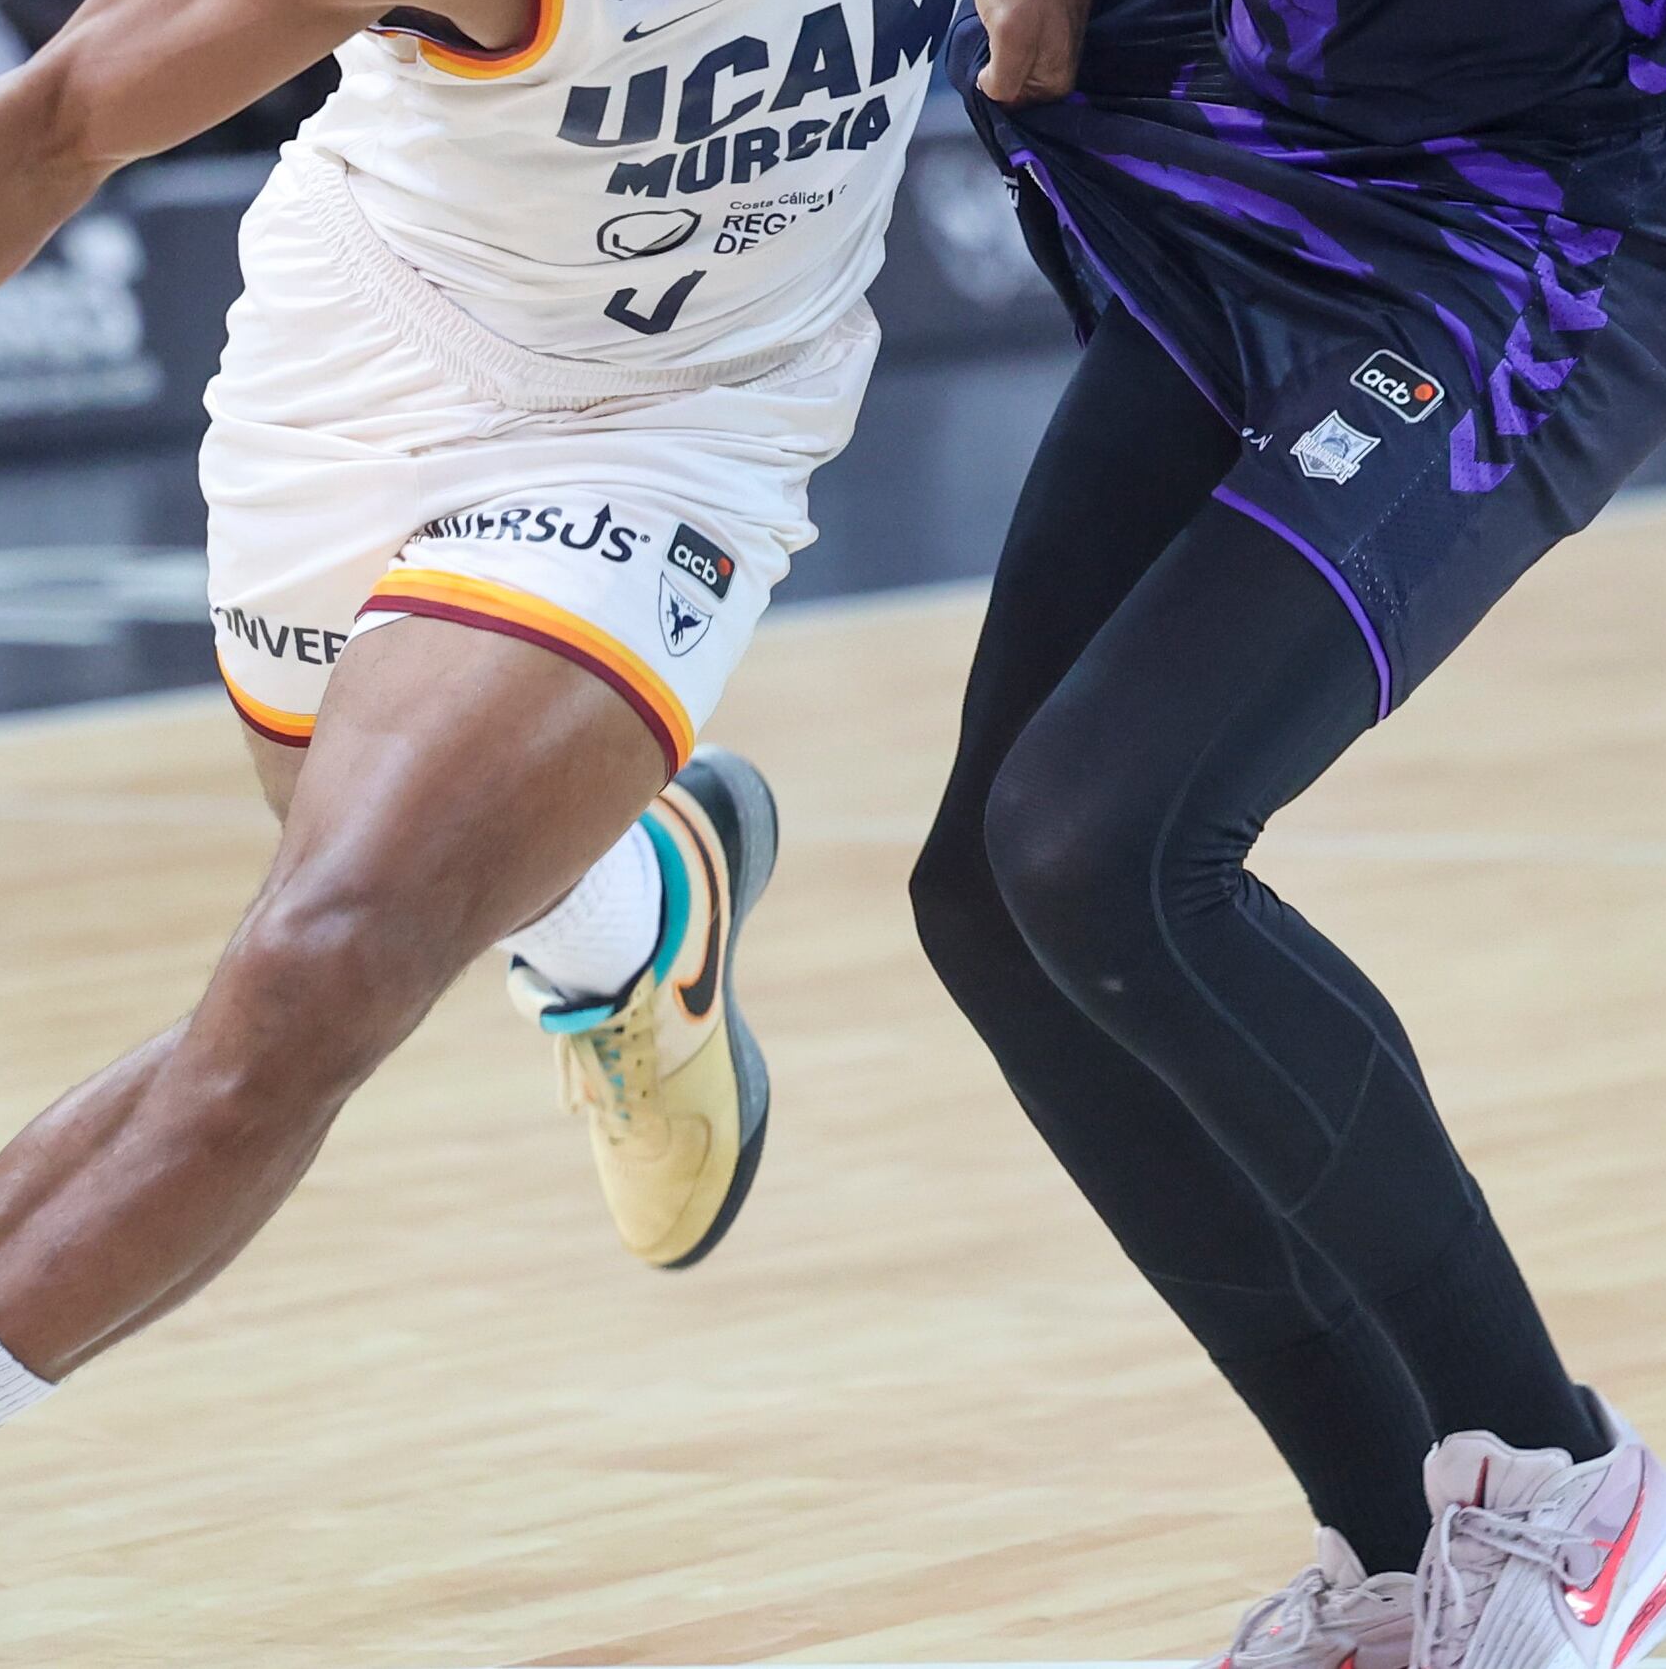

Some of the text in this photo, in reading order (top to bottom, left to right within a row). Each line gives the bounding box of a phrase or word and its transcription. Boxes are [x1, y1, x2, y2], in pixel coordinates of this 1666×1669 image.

[605, 94, 891, 198] MURCIA
[730, 200, 774, 211] Costa
[1362, 368, 1411, 405] acb
[674, 544, 718, 586] acb
